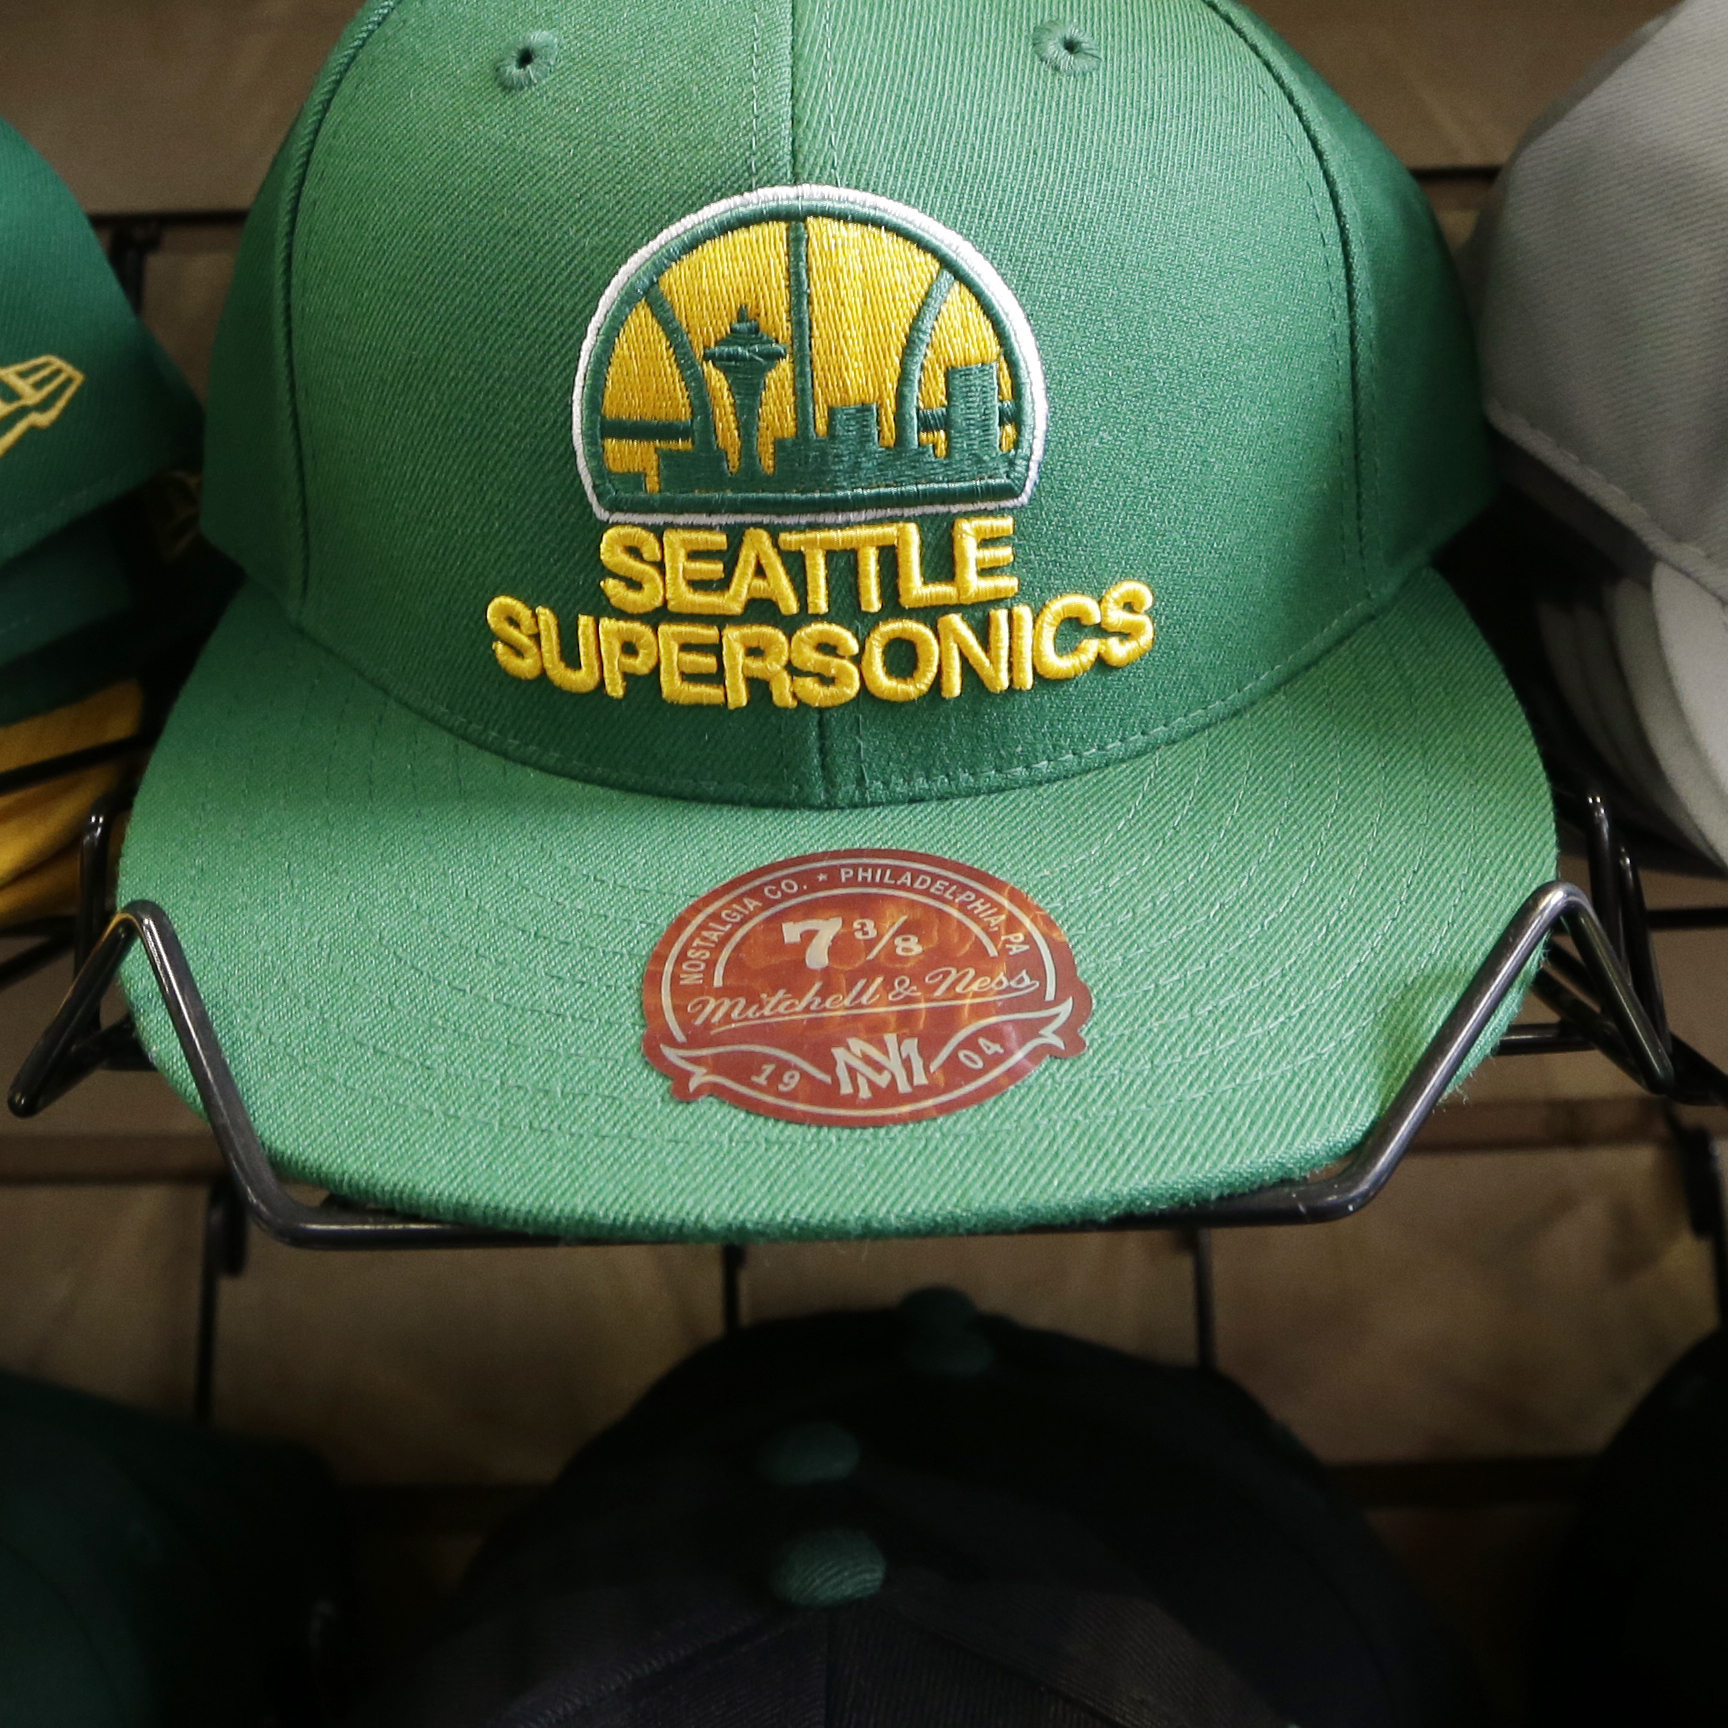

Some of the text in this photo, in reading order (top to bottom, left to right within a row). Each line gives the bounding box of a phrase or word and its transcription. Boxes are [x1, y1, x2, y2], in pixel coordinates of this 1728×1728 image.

[599, 515, 1020, 615] SEATTLE
[486, 579, 1155, 710] SUPERSONICS
[679, 878, 808, 985] NOSTALGIA CO.
[840, 866, 1031, 956] PHILADELPHIA, PA
[687, 966, 1041, 1026] Mitchell & Ness
